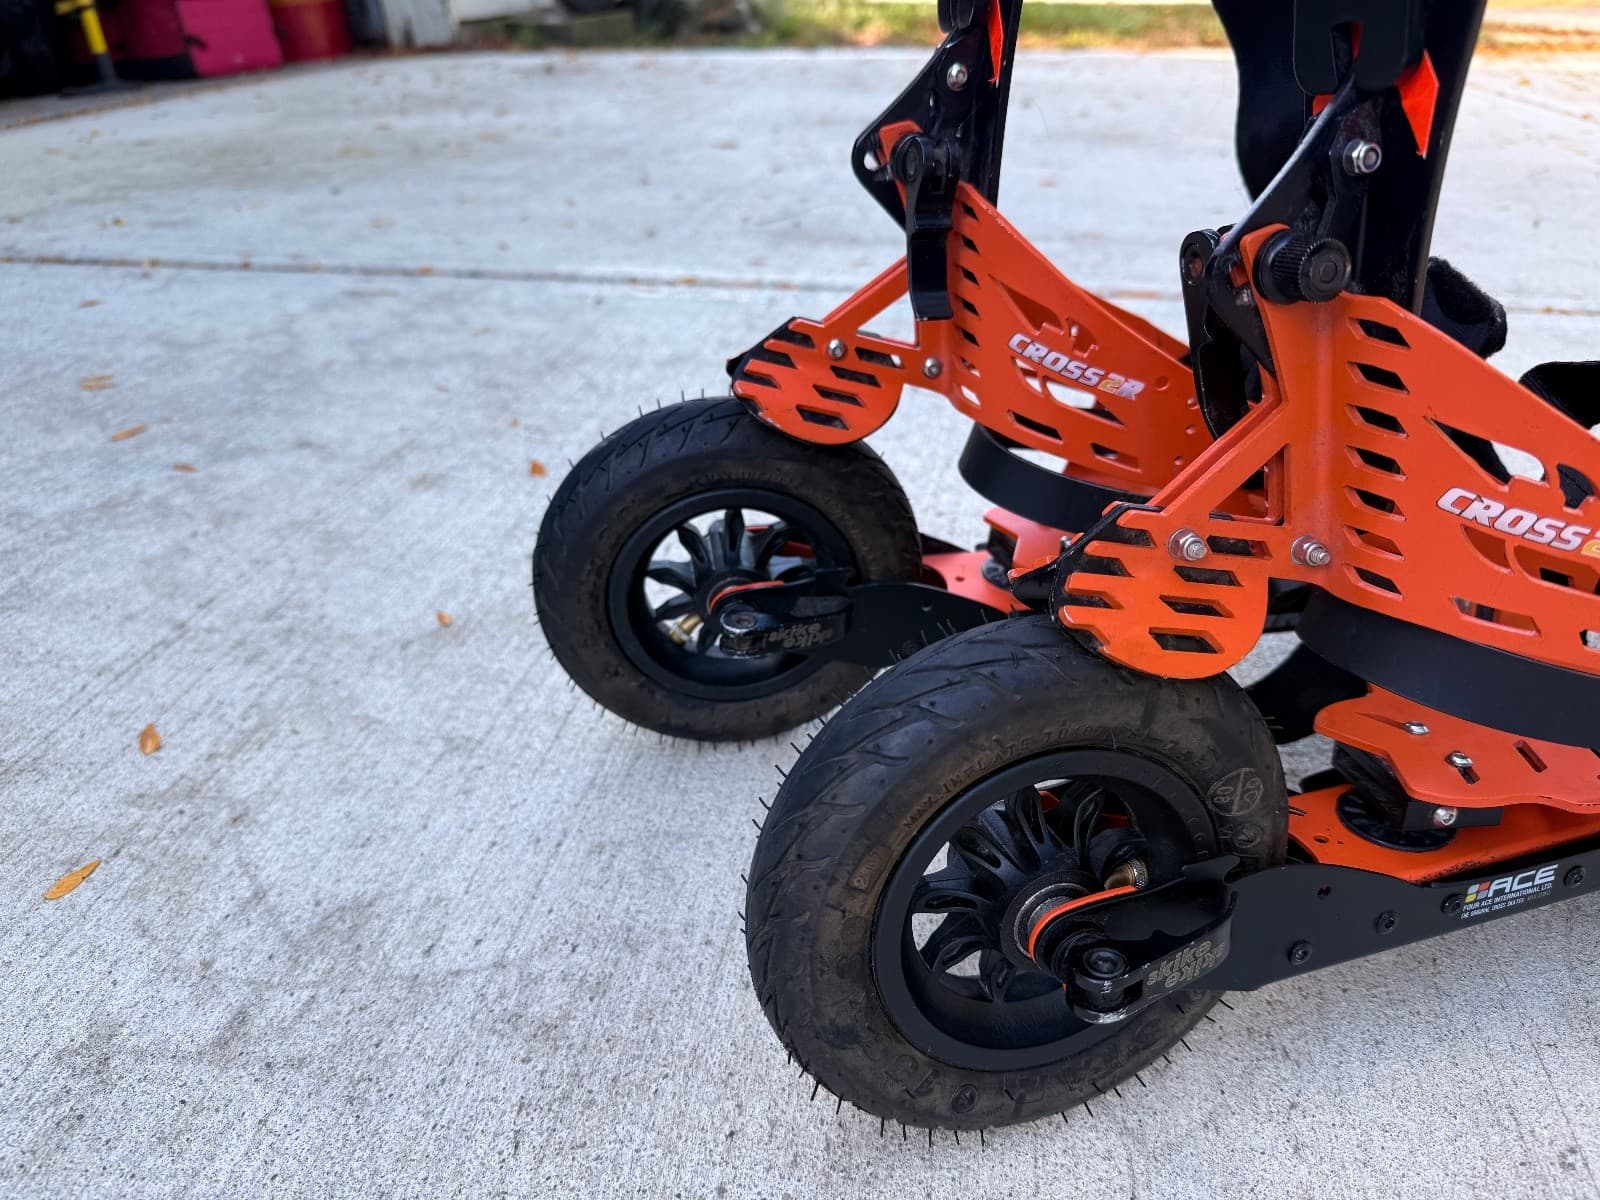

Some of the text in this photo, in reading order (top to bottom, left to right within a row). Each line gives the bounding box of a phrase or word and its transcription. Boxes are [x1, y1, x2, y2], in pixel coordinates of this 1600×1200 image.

[1488, 864, 1558, 898] ACE
[1463, 900, 1480, 912] FOUR
[1481, 898, 1493, 906] ACE
[1493, 887, 1540, 903] INTERNATIONAL
